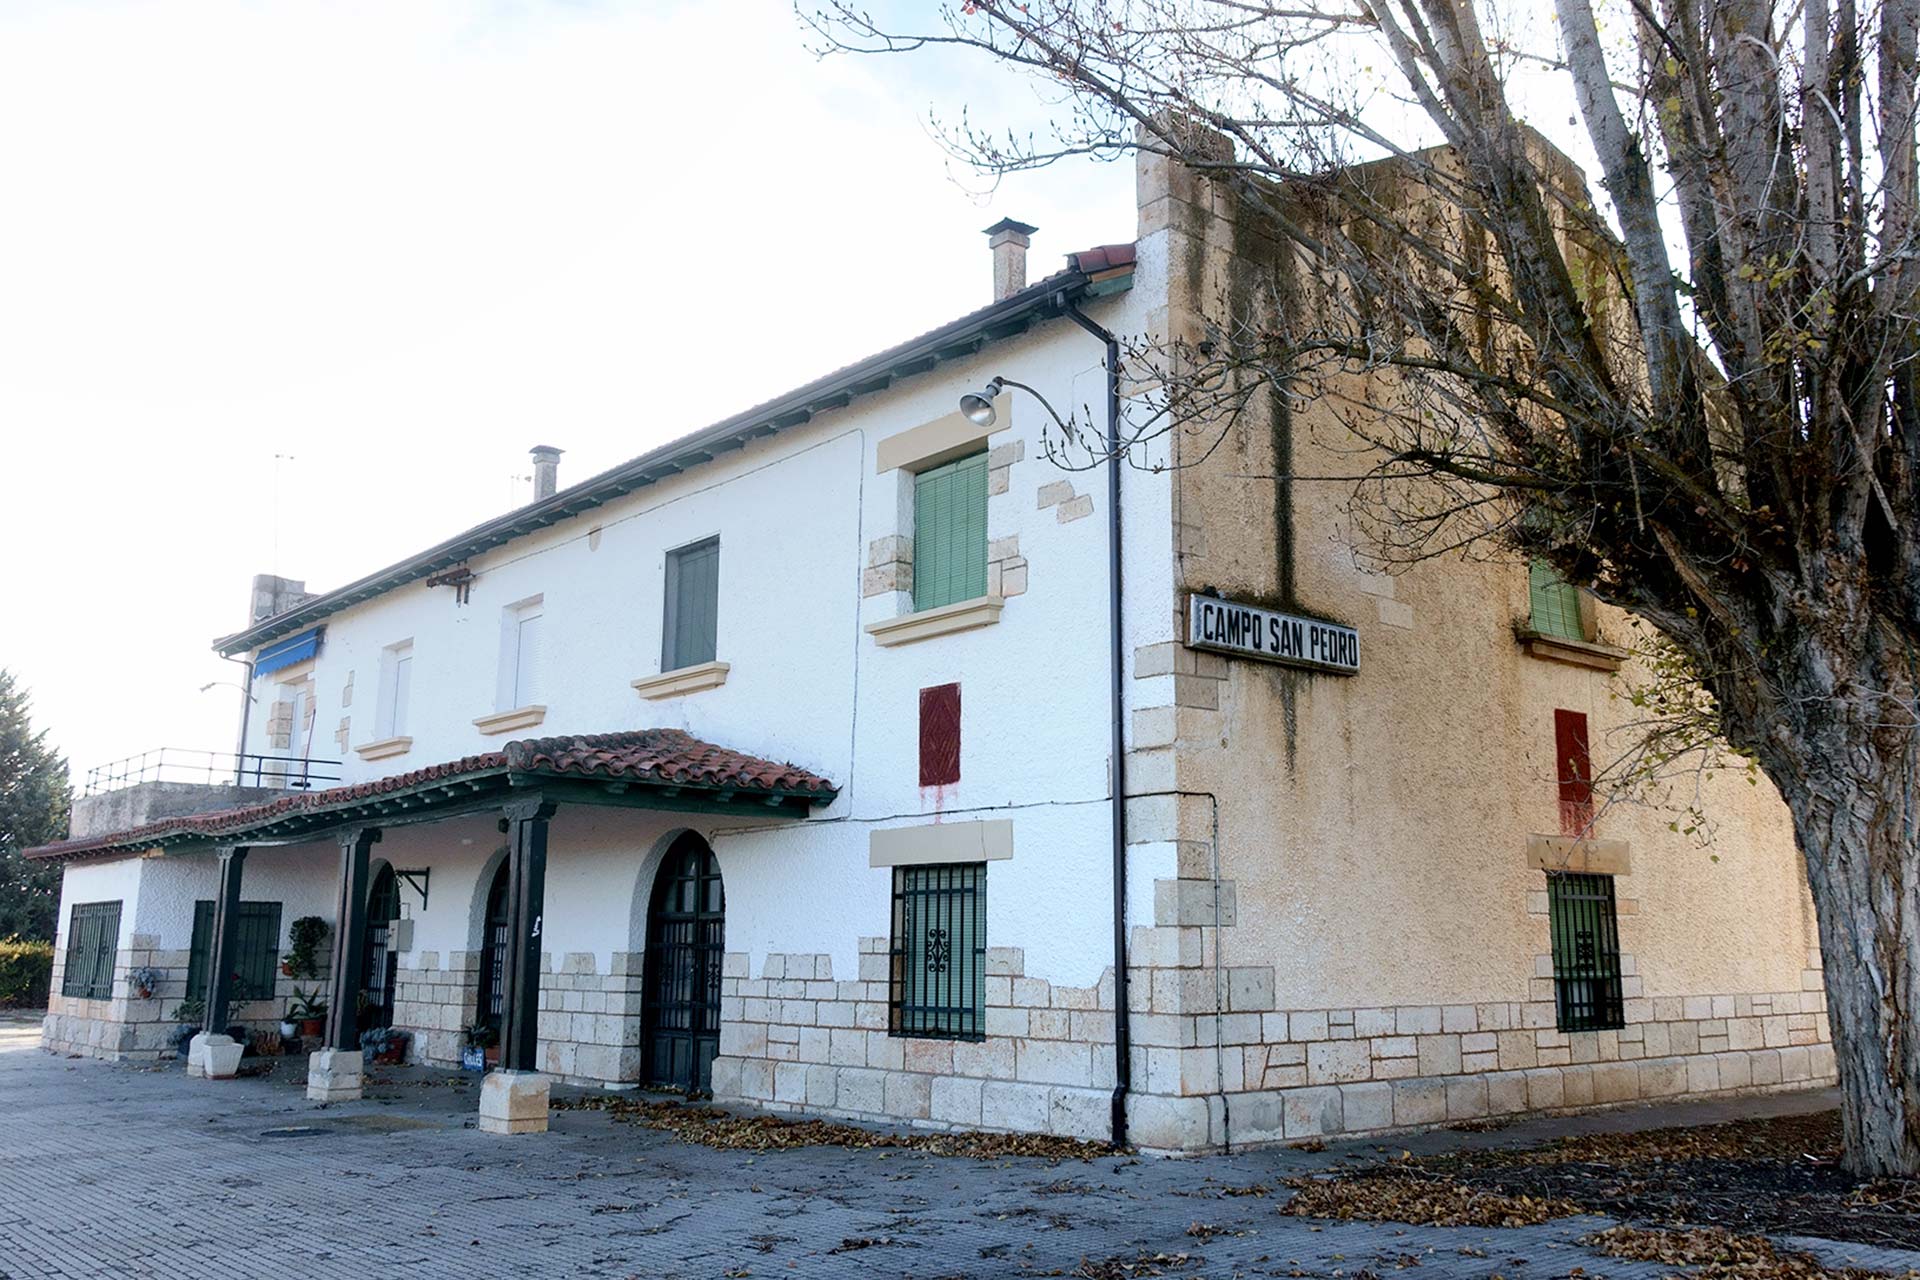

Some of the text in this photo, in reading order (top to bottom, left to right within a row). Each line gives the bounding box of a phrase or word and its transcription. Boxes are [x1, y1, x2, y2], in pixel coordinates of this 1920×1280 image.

[1203, 604, 1358, 666] CAMPO SAN PEDRO
